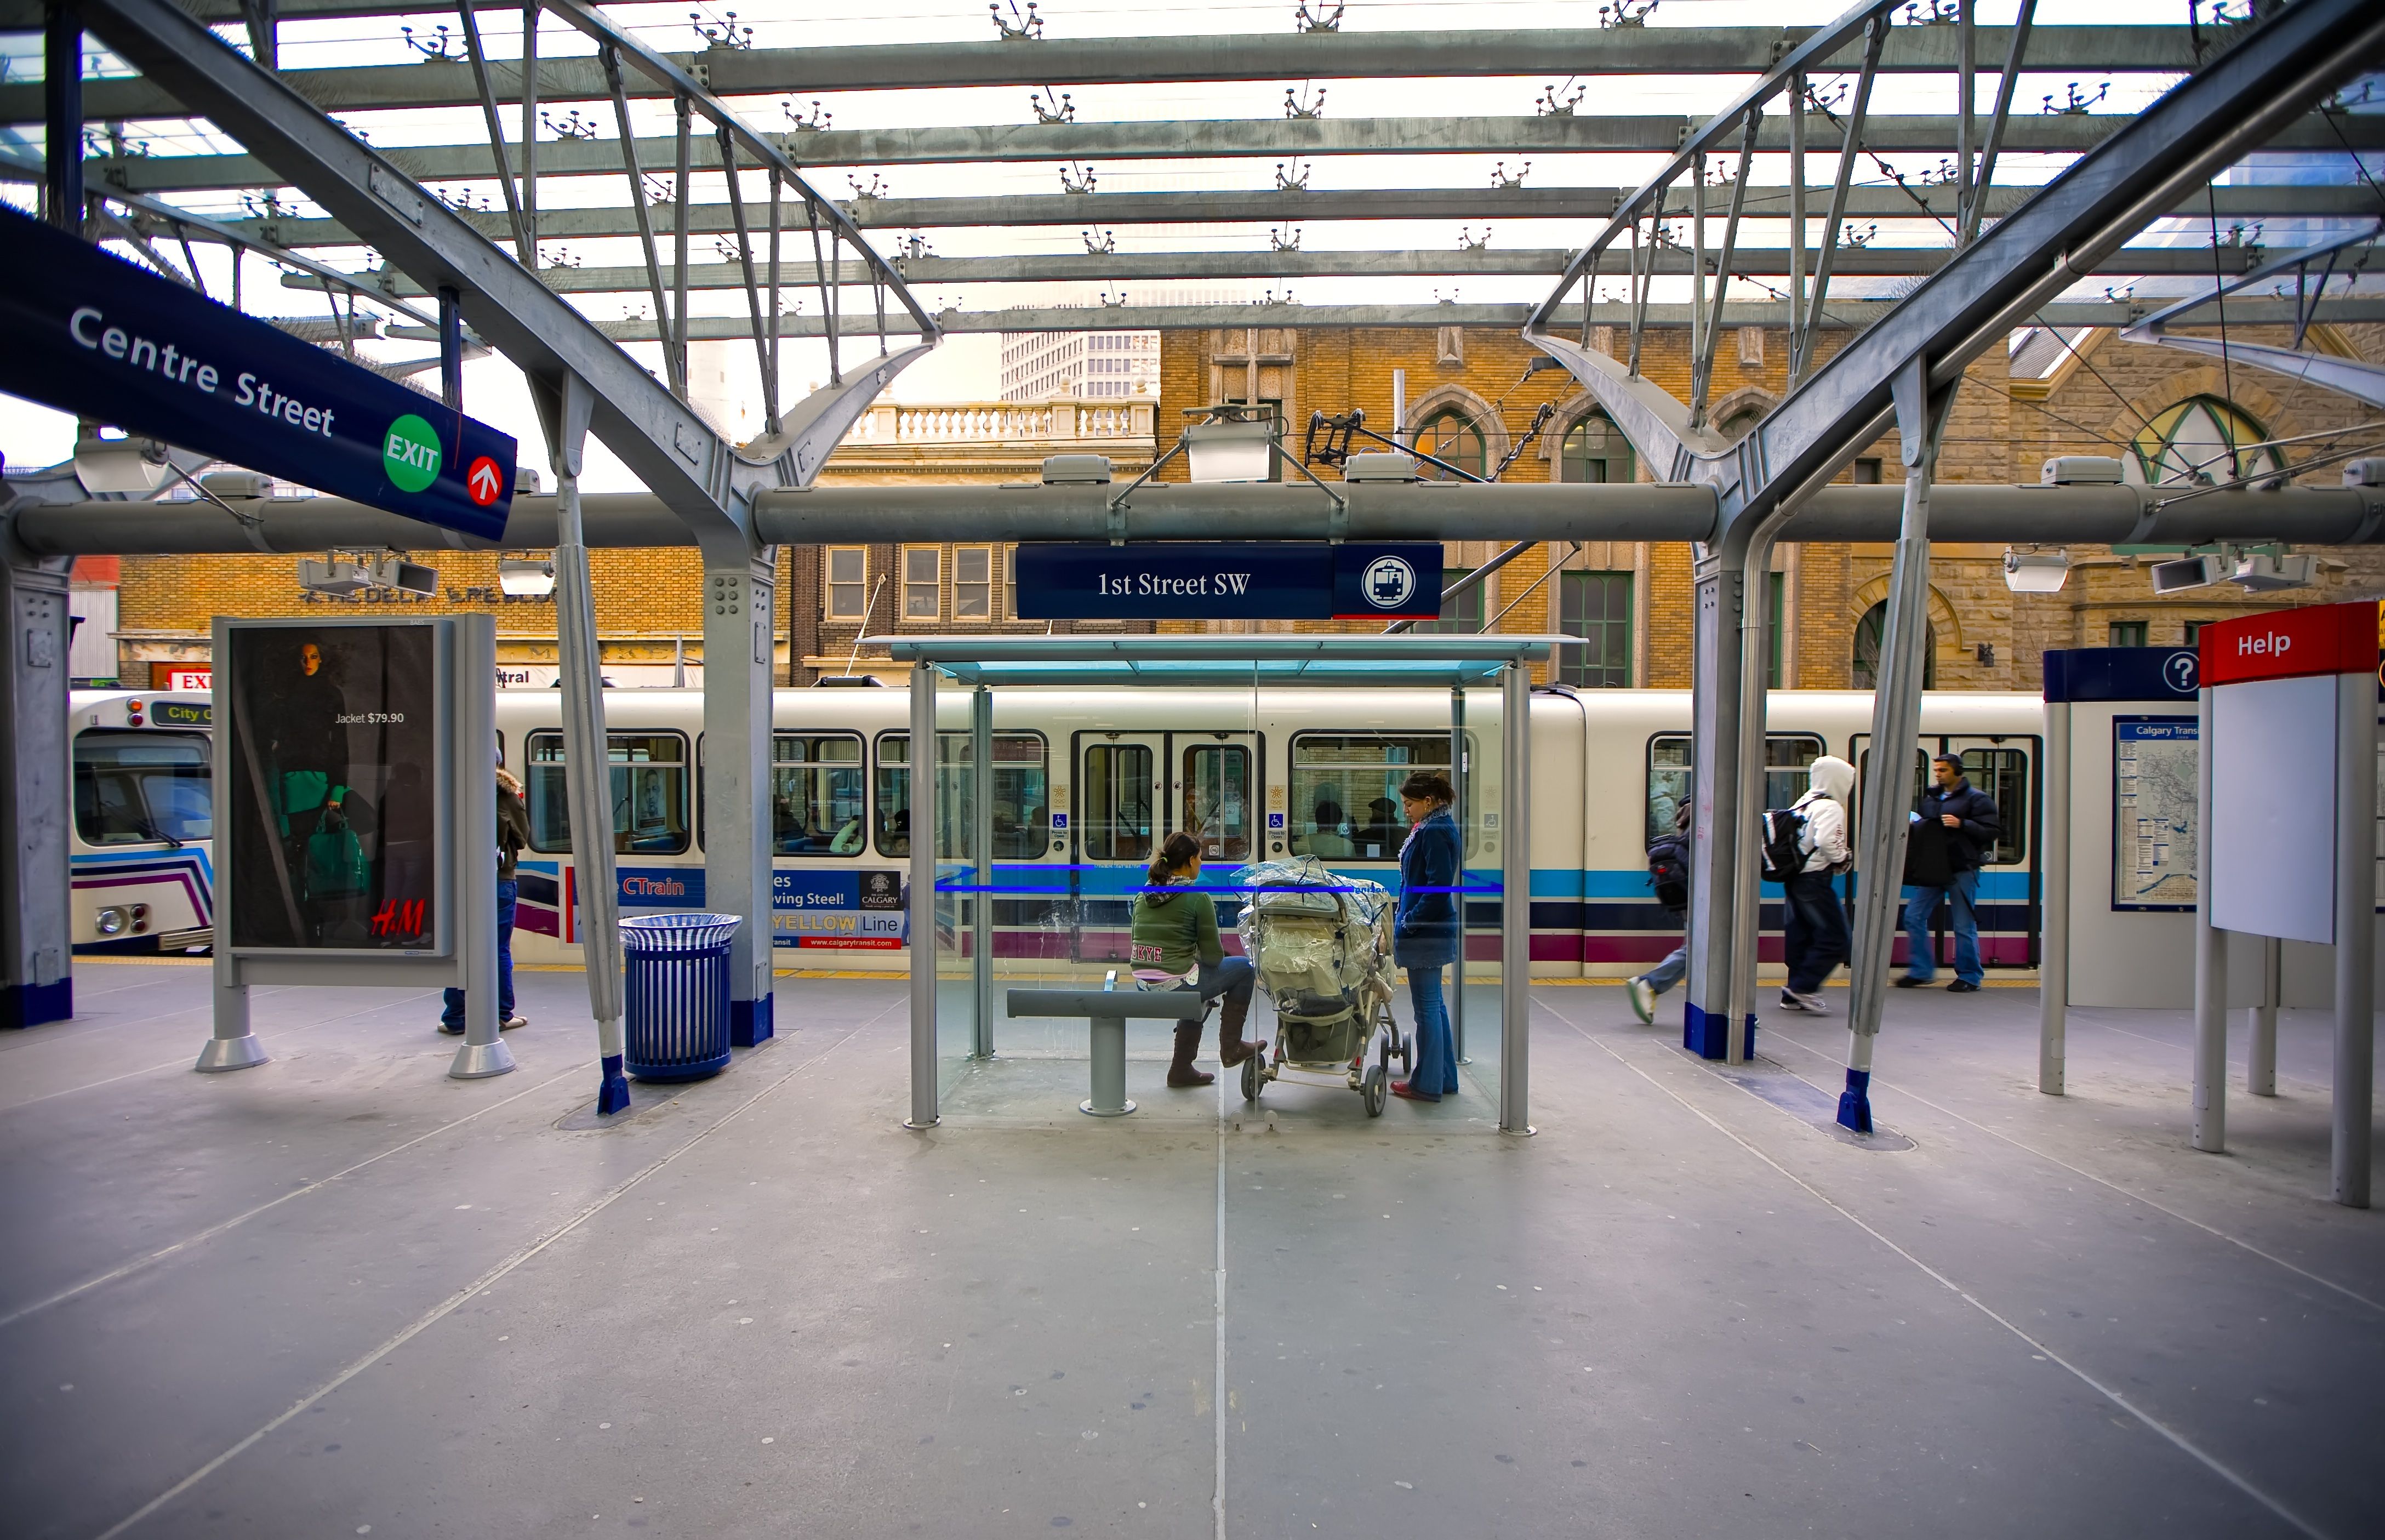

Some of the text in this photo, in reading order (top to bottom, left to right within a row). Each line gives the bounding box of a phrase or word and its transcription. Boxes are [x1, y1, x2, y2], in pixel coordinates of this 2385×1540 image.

[70, 306, 335, 438] Centre Street
[386, 433, 440, 472] EXIT
[1098, 573, 1251, 595] 1st Street SW
[2238, 631, 2291, 657] Help
[168, 706, 199, 722] City
[335, 712, 404, 725] Jacket $79.90
[2136, 726, 2172, 737] Calgary
[623, 877, 684, 895] CTrain
[773, 876, 791, 887] es
[772, 893, 845, 907] ving Steel!
[370, 898, 426, 937] H&M
[772, 915, 898, 931] YELLOW Line
[811, 939, 892, 948] www.calgarytransit.com
